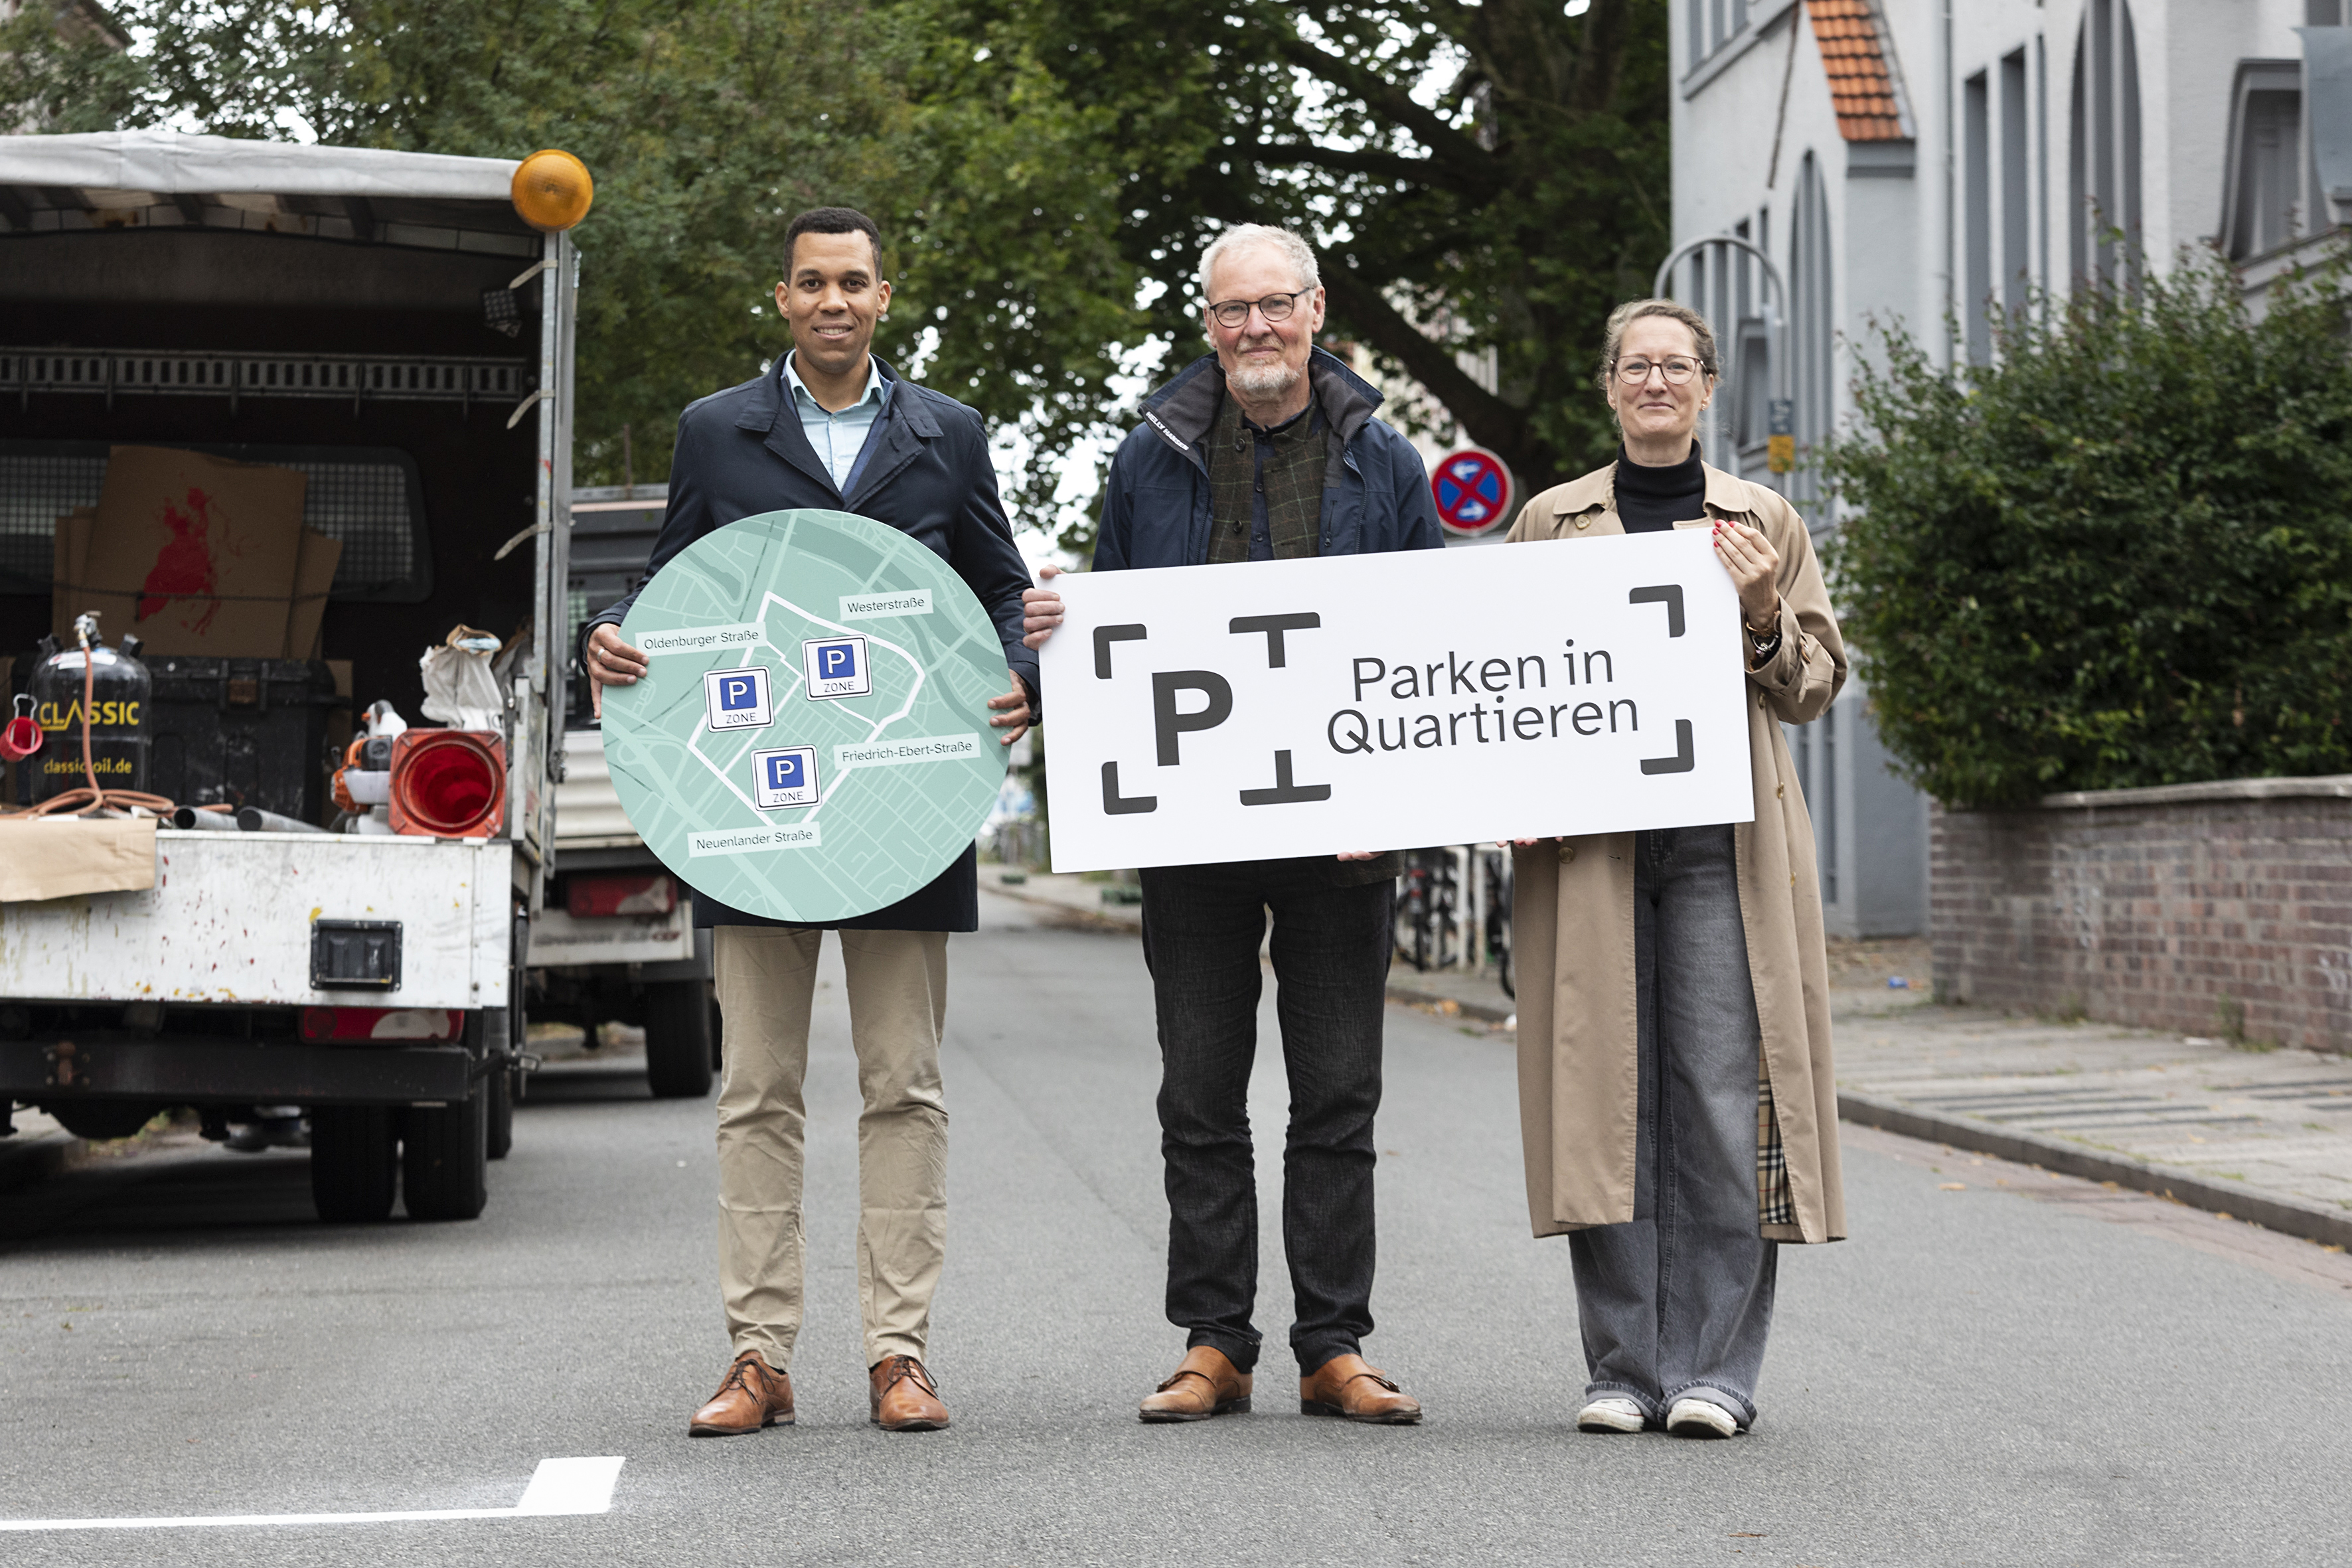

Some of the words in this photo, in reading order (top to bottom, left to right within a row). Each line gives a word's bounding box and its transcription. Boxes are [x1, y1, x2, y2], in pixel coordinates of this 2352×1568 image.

[847, 597, 925, 613] Westerstraße
[644, 635, 716, 649] Oldenburger
[720, 630, 759, 643] Straße
[826, 650, 846, 674] P
[1353, 651, 1547, 702] Parken
[1563, 639, 1613, 686] in
[728, 680, 747, 705] P
[823, 681, 855, 693] ZONE
[39, 698, 140, 732] CLASSIC
[725, 712, 757, 724] ZONE
[1151, 670, 1233, 767] P
[1327, 696, 1638, 755] Quartieren
[842, 741, 973, 761] Friedrich-Ebert-Straße
[43, 757, 133, 775] classicoil.de
[775, 759, 795, 784] P
[772, 791, 804, 803] ZONE
[696, 834, 771, 849] Neuenlander
[775, 829, 813, 842] Straße
